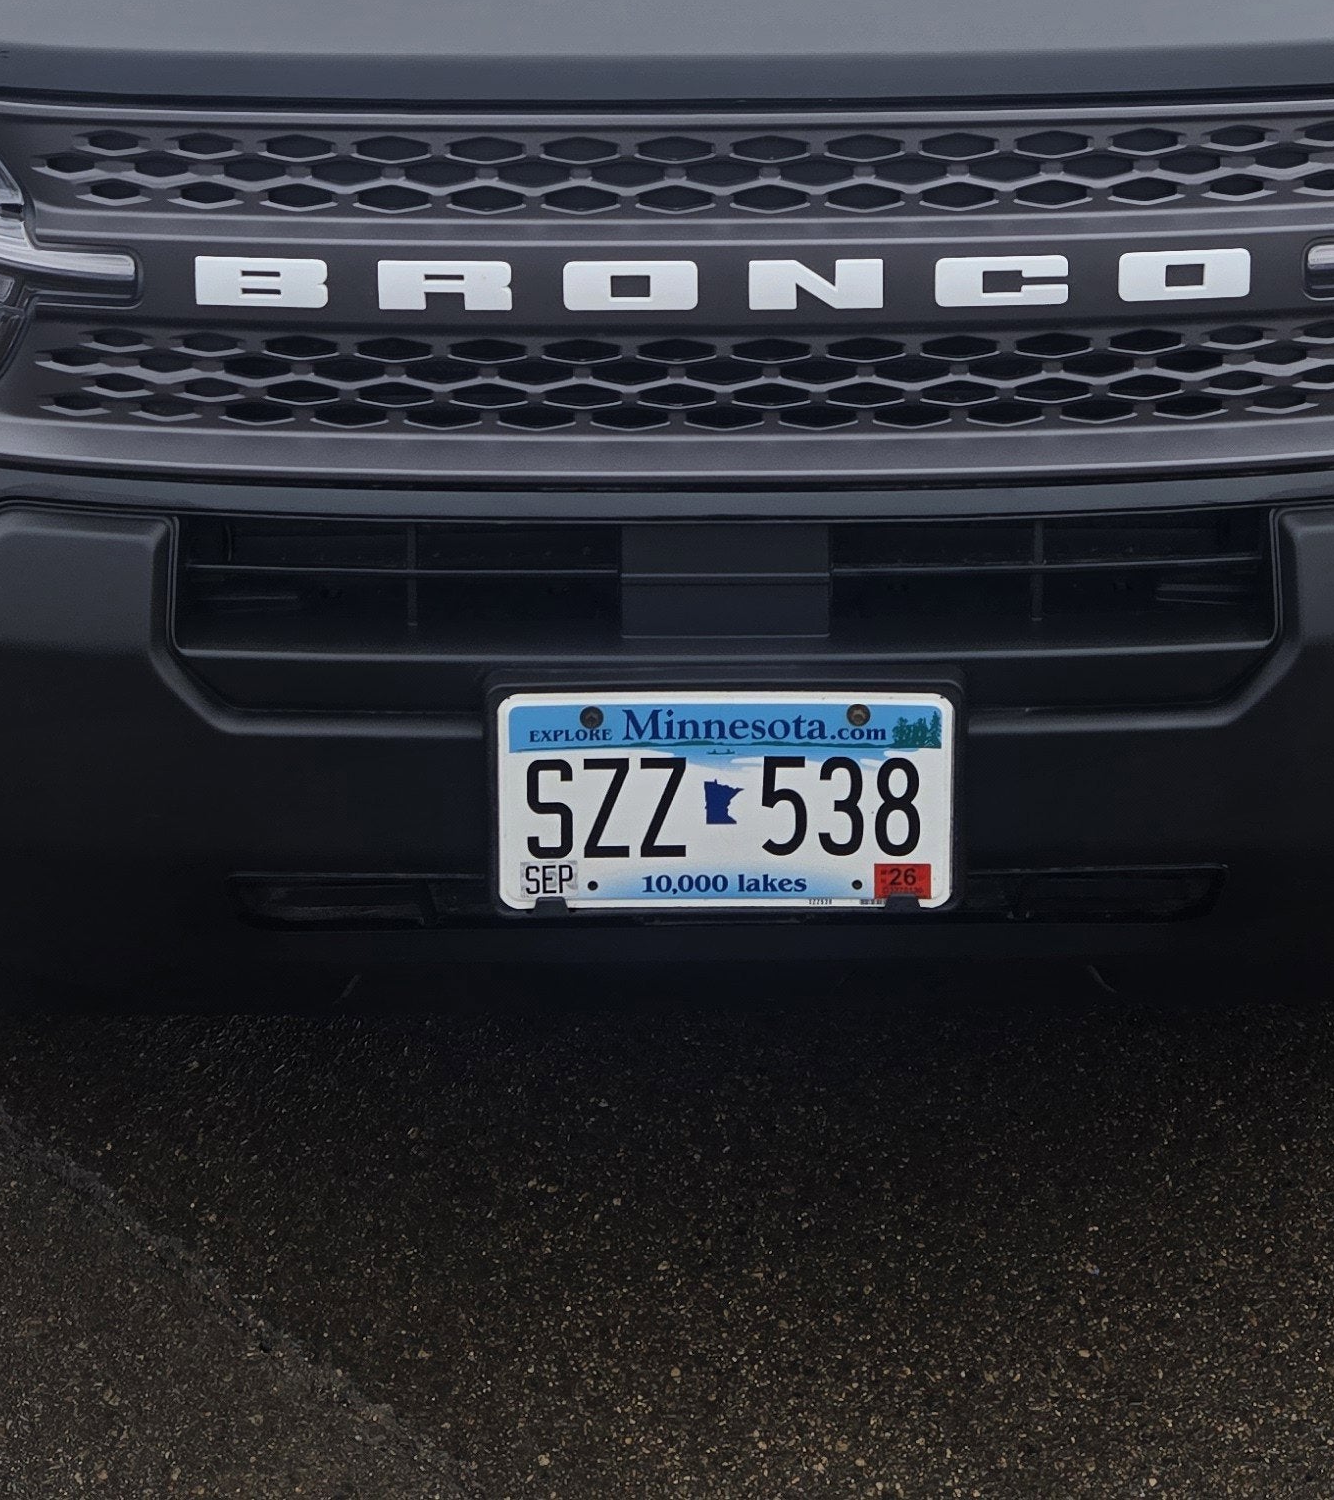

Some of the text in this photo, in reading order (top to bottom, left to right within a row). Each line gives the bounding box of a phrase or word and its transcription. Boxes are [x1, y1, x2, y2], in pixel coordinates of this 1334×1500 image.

[195, 248, 1251, 312] BRONCO
[529, 709, 887, 742] EXPLORE Minnesota.com
[525, 756, 921, 859] SZZ 538
[525, 864, 574, 895] SEP
[642, 874, 807, 895] 10,000 lakes
[889, 867, 916, 886] 26
